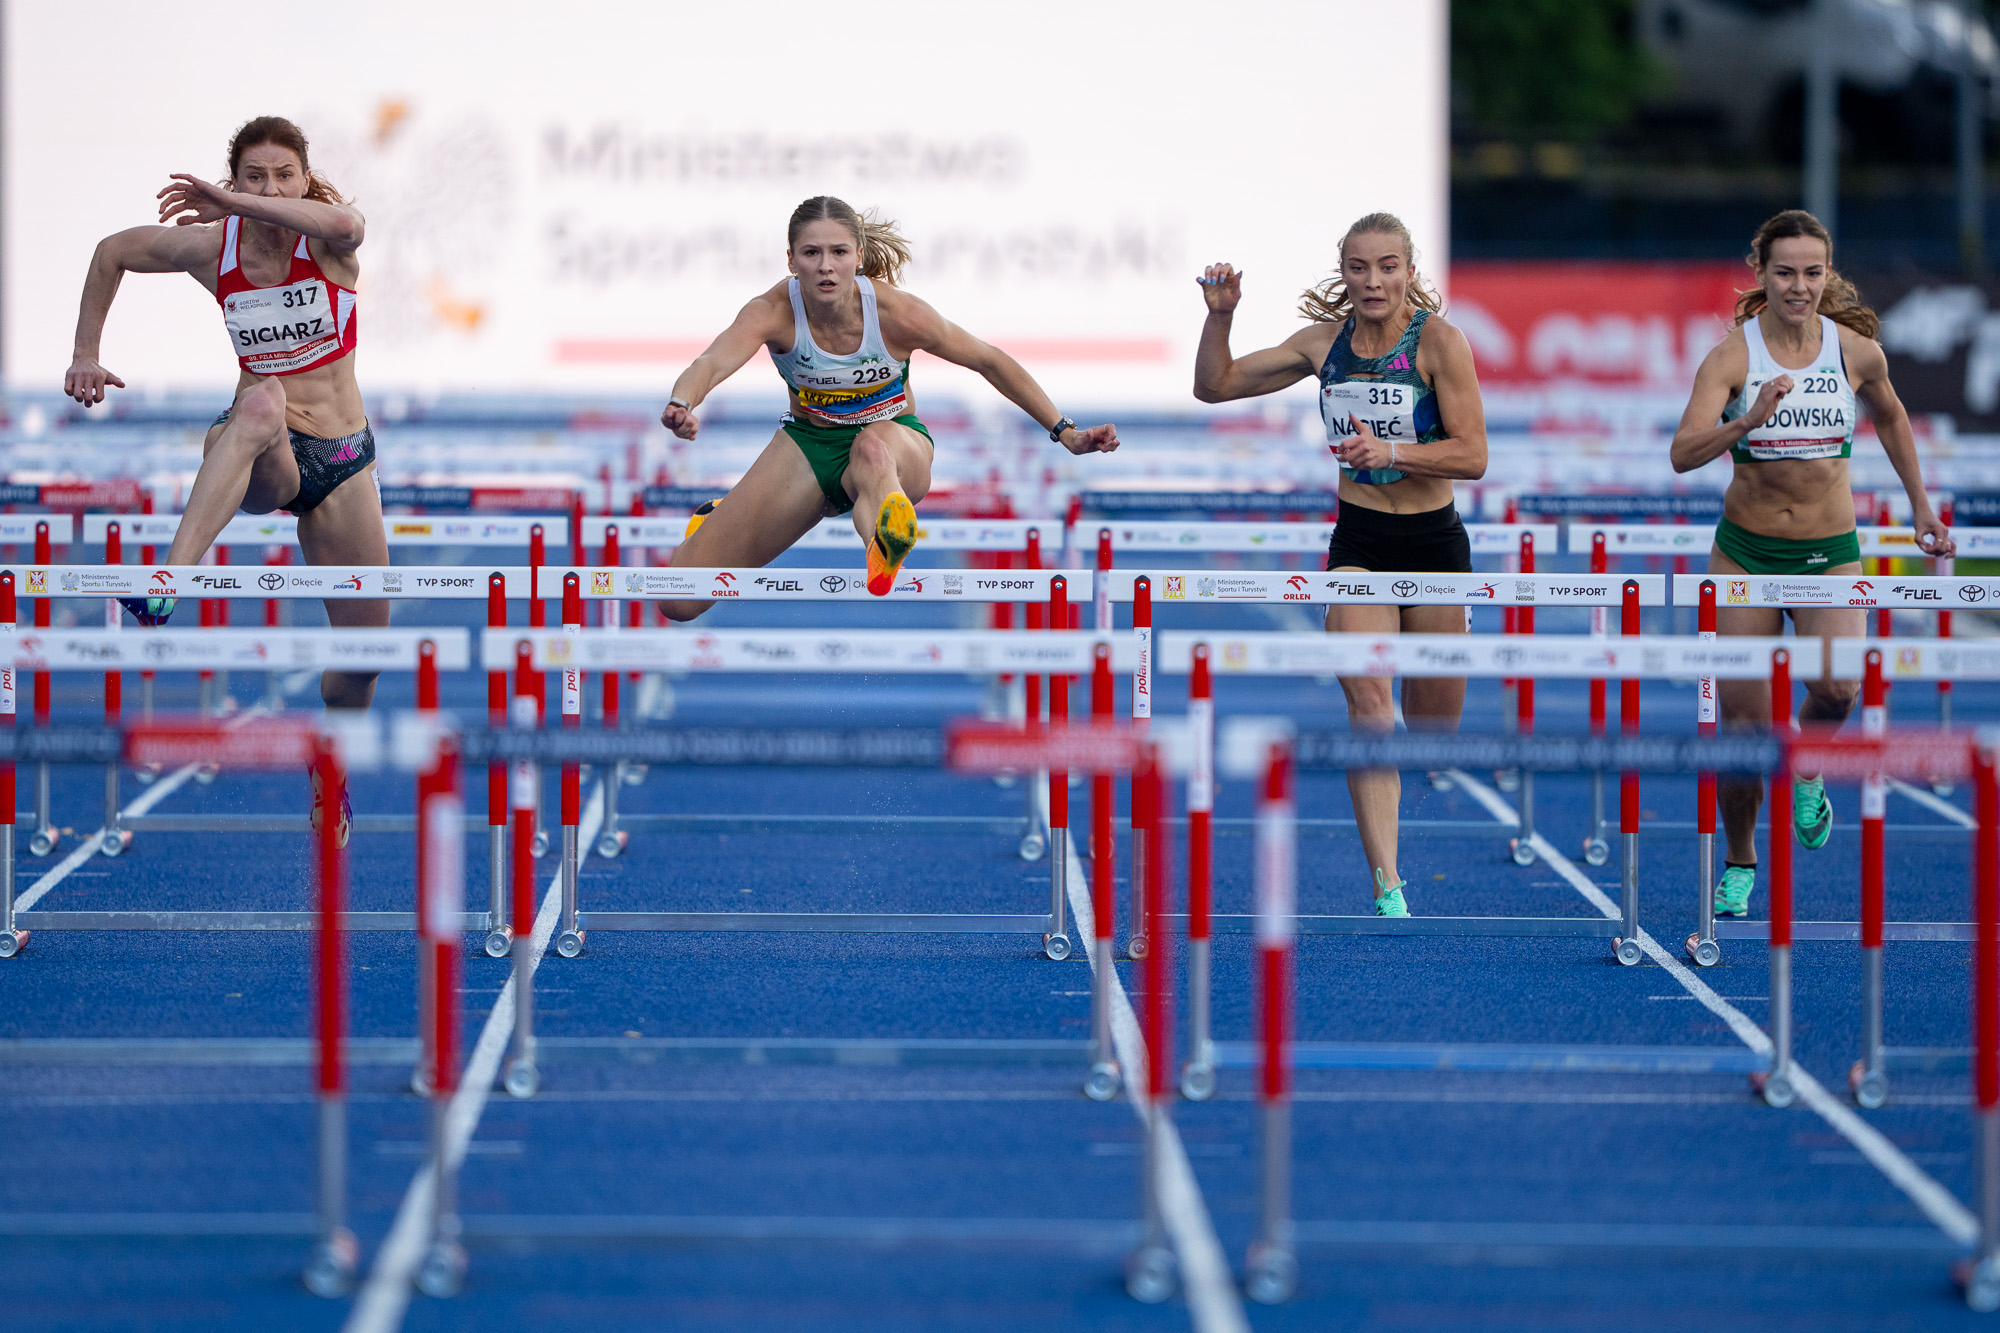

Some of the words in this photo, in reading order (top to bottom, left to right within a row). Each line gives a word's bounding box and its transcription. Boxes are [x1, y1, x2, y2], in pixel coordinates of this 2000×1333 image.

[283, 286, 317, 308] 317
[239, 318, 324, 346] SICIARZ
[308, 339, 324, 350] Polski
[274, 351, 319, 368] WIELKOPOLSKI
[853, 367, 891, 384] 228
[1804, 378, 1838, 393] 220
[1369, 388, 1402, 405] 315
[876, 400, 894, 411] Polski
[292, 578, 322, 587] Okęcie
[441, 578, 474, 587] SPORT
[670, 582, 695, 590] Turystyki
[977, 580, 998, 589] TVP
[1000, 580, 1034, 589] SPORT
[894, 585, 916, 593] polanik
[1241, 586, 1267, 594] Turystyki
[1425, 585, 1456, 594] Okęcie
[1549, 587, 1570, 596] TVP
[1572, 587, 1607, 596] SPORT
[1807, 591, 1833, 599] Turystyki
